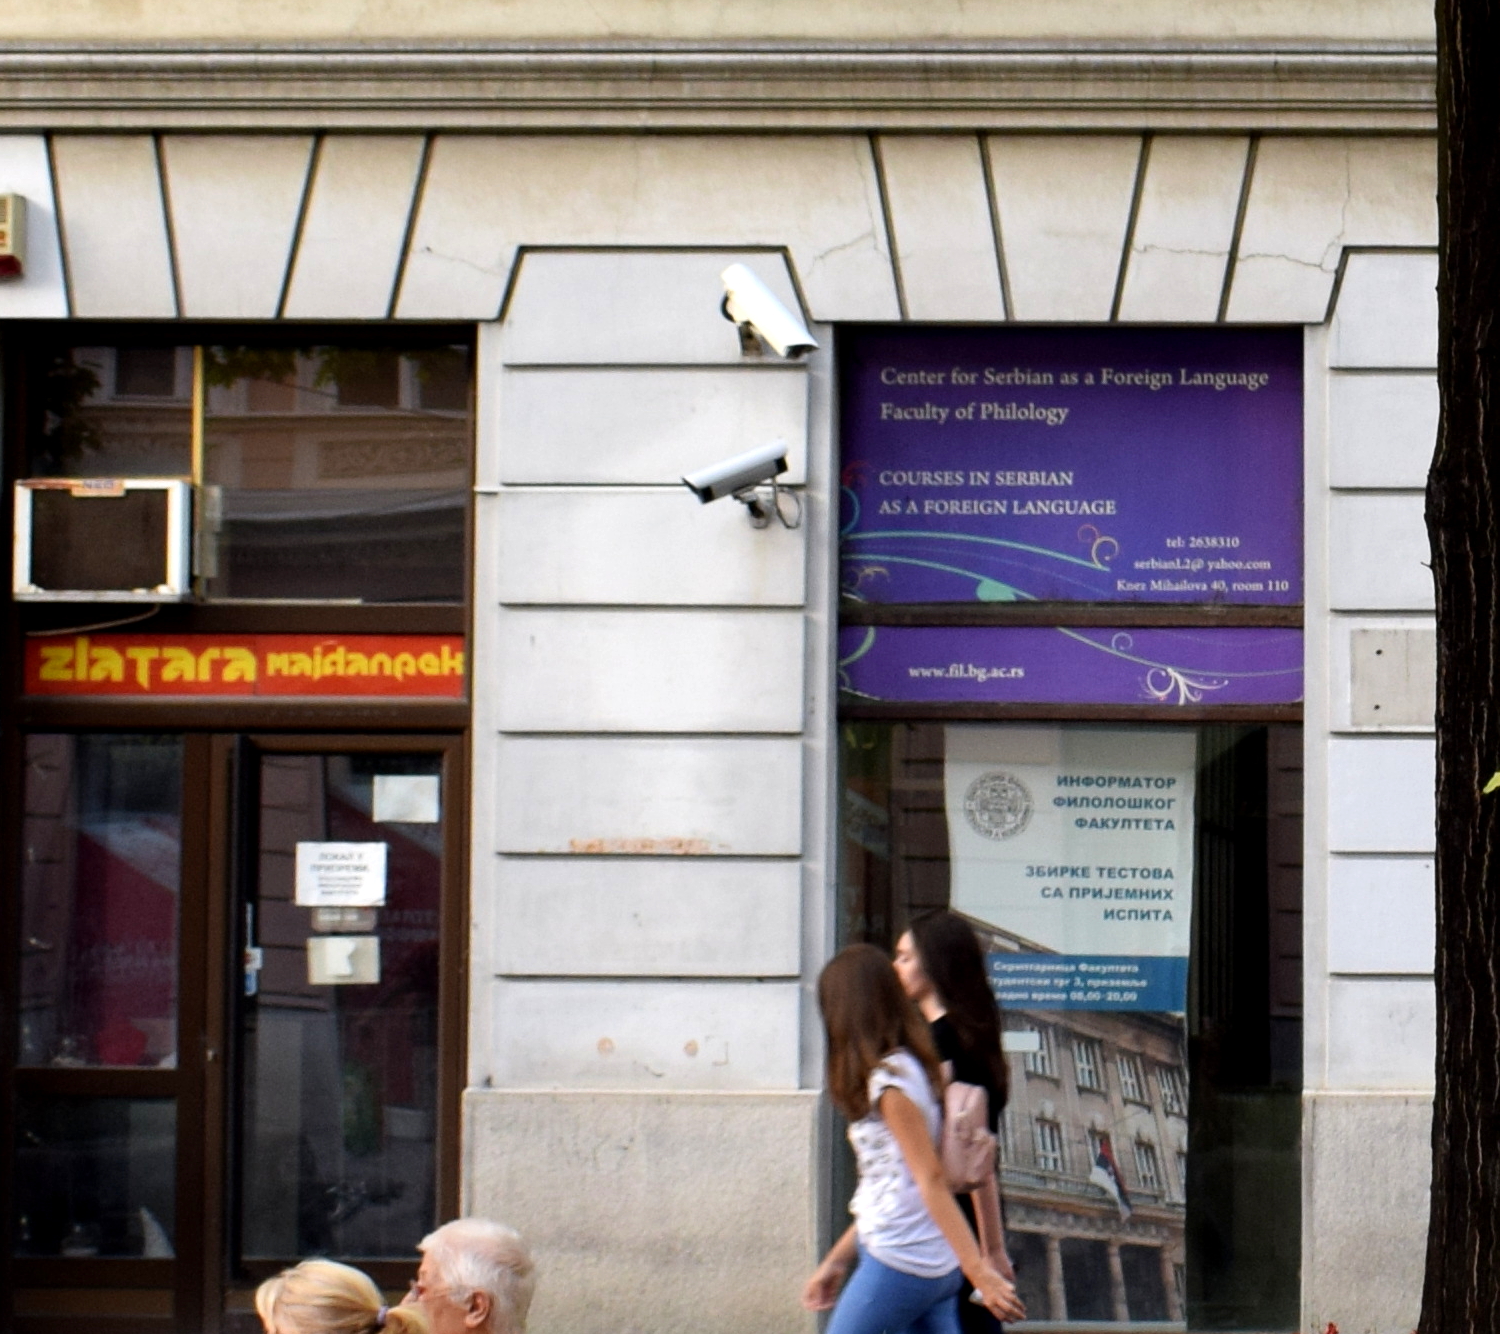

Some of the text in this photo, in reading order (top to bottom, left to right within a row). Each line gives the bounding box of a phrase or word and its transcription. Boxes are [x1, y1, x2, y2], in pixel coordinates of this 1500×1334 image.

[880, 366, 1269, 391] Center for Serbian as a Foreign Language
[880, 402, 1069, 425] Faculty of Philology
[879, 470, 1074, 486] COURSES IN SERBIAN
[879, 499, 1116, 515] AS A FOREIGN LANGUAGE
[1166, 537, 1240, 548] tel: 2638310
[1207, 557, 1271, 572] yahoo.com
[1151, 579, 1207, 591] Mihailova
[1232, 582, 1263, 591] room
[1268, 580, 1290, 591] 110
[908, 663, 1025, 683] www.fil.bg.ac.rs
[1056, 775, 1177, 789] ИНФОРМАТОР
[1053, 796, 1176, 810] ФИЛОЛОШКОГ
[1075, 818, 1176, 831] ФАКУЛТЕТА
[1025, 865, 1174, 880] ЗБИРКЕ ТЕСТОВА
[1041, 886, 1174, 901] СА ПРИЈЕМНИХ
[1103, 908, 1174, 922] ИСПИТА
